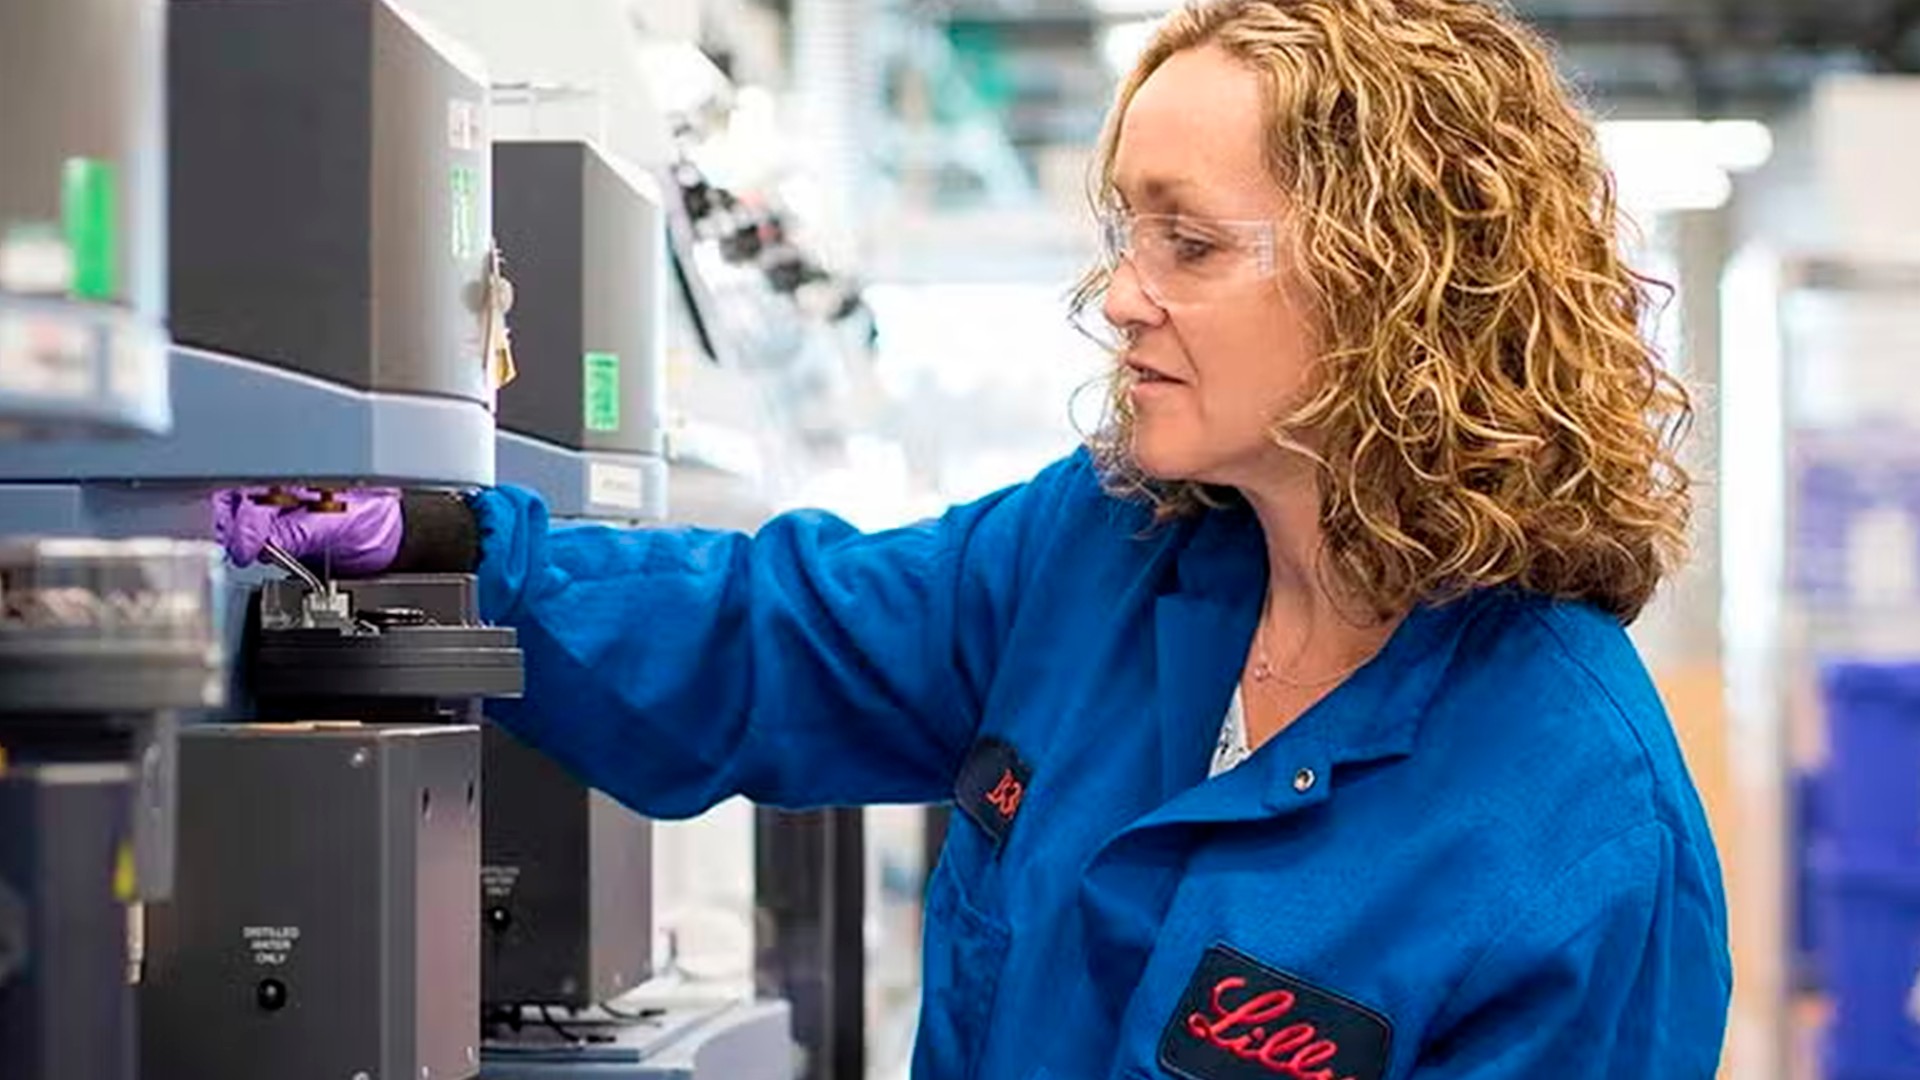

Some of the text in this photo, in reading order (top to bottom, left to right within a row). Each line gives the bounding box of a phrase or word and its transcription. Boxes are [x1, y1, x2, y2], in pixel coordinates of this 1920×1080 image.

[243, 926, 299, 938] DISTILLED
[250, 939, 291, 950] WATER
[255, 952, 286, 965] ONLY
[1188, 976, 1356, 1080] Lill
